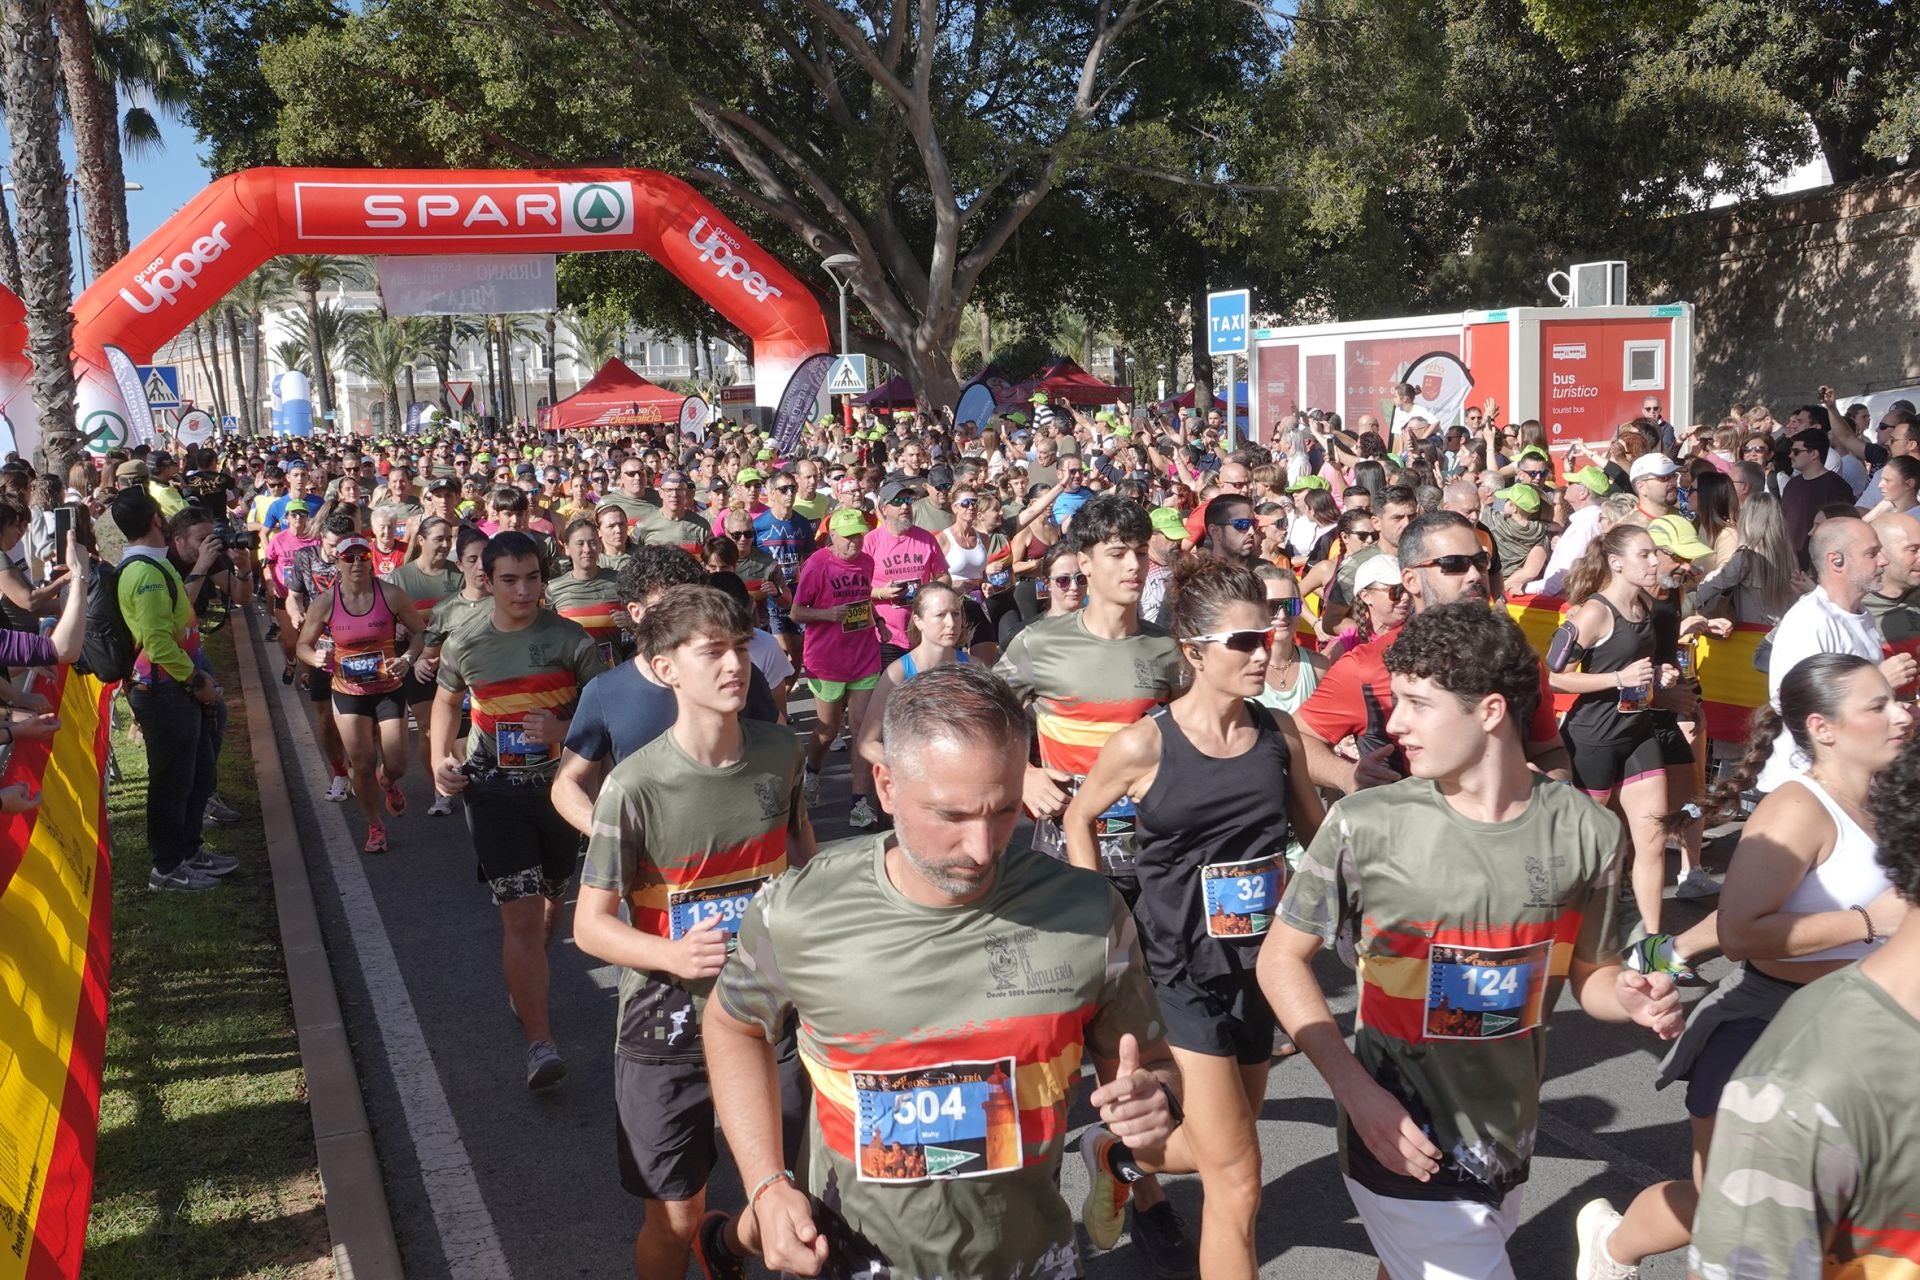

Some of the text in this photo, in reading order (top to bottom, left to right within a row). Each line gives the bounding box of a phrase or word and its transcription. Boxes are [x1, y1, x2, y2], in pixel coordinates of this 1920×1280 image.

[364, 194, 557, 228] SPAR
[714, 226, 741, 250] grupo
[134, 257, 164, 285] grupo
[1212, 314, 1245, 332] TAXI
[1553, 373, 1575, 385] bus
[1553, 385, 1598, 399] turístico
[1553, 406, 1585, 415] tourist bus
[882, 552, 923, 569] UCAM
[884, 565, 926, 576] UNIVERSIDAD
[831, 574, 870, 590] UCAM
[1236, 875, 1266, 901] 32
[688, 896, 749, 924] 1339
[1014, 928, 1039, 945] CROSS
[1020, 960, 1035, 975] LA
[1026, 961, 1075, 989] ARTILLERÍA
[1462, 967, 1518, 996] 124
[901, 1078, 930, 1090] CROSS
[893, 1086, 967, 1125] 504
